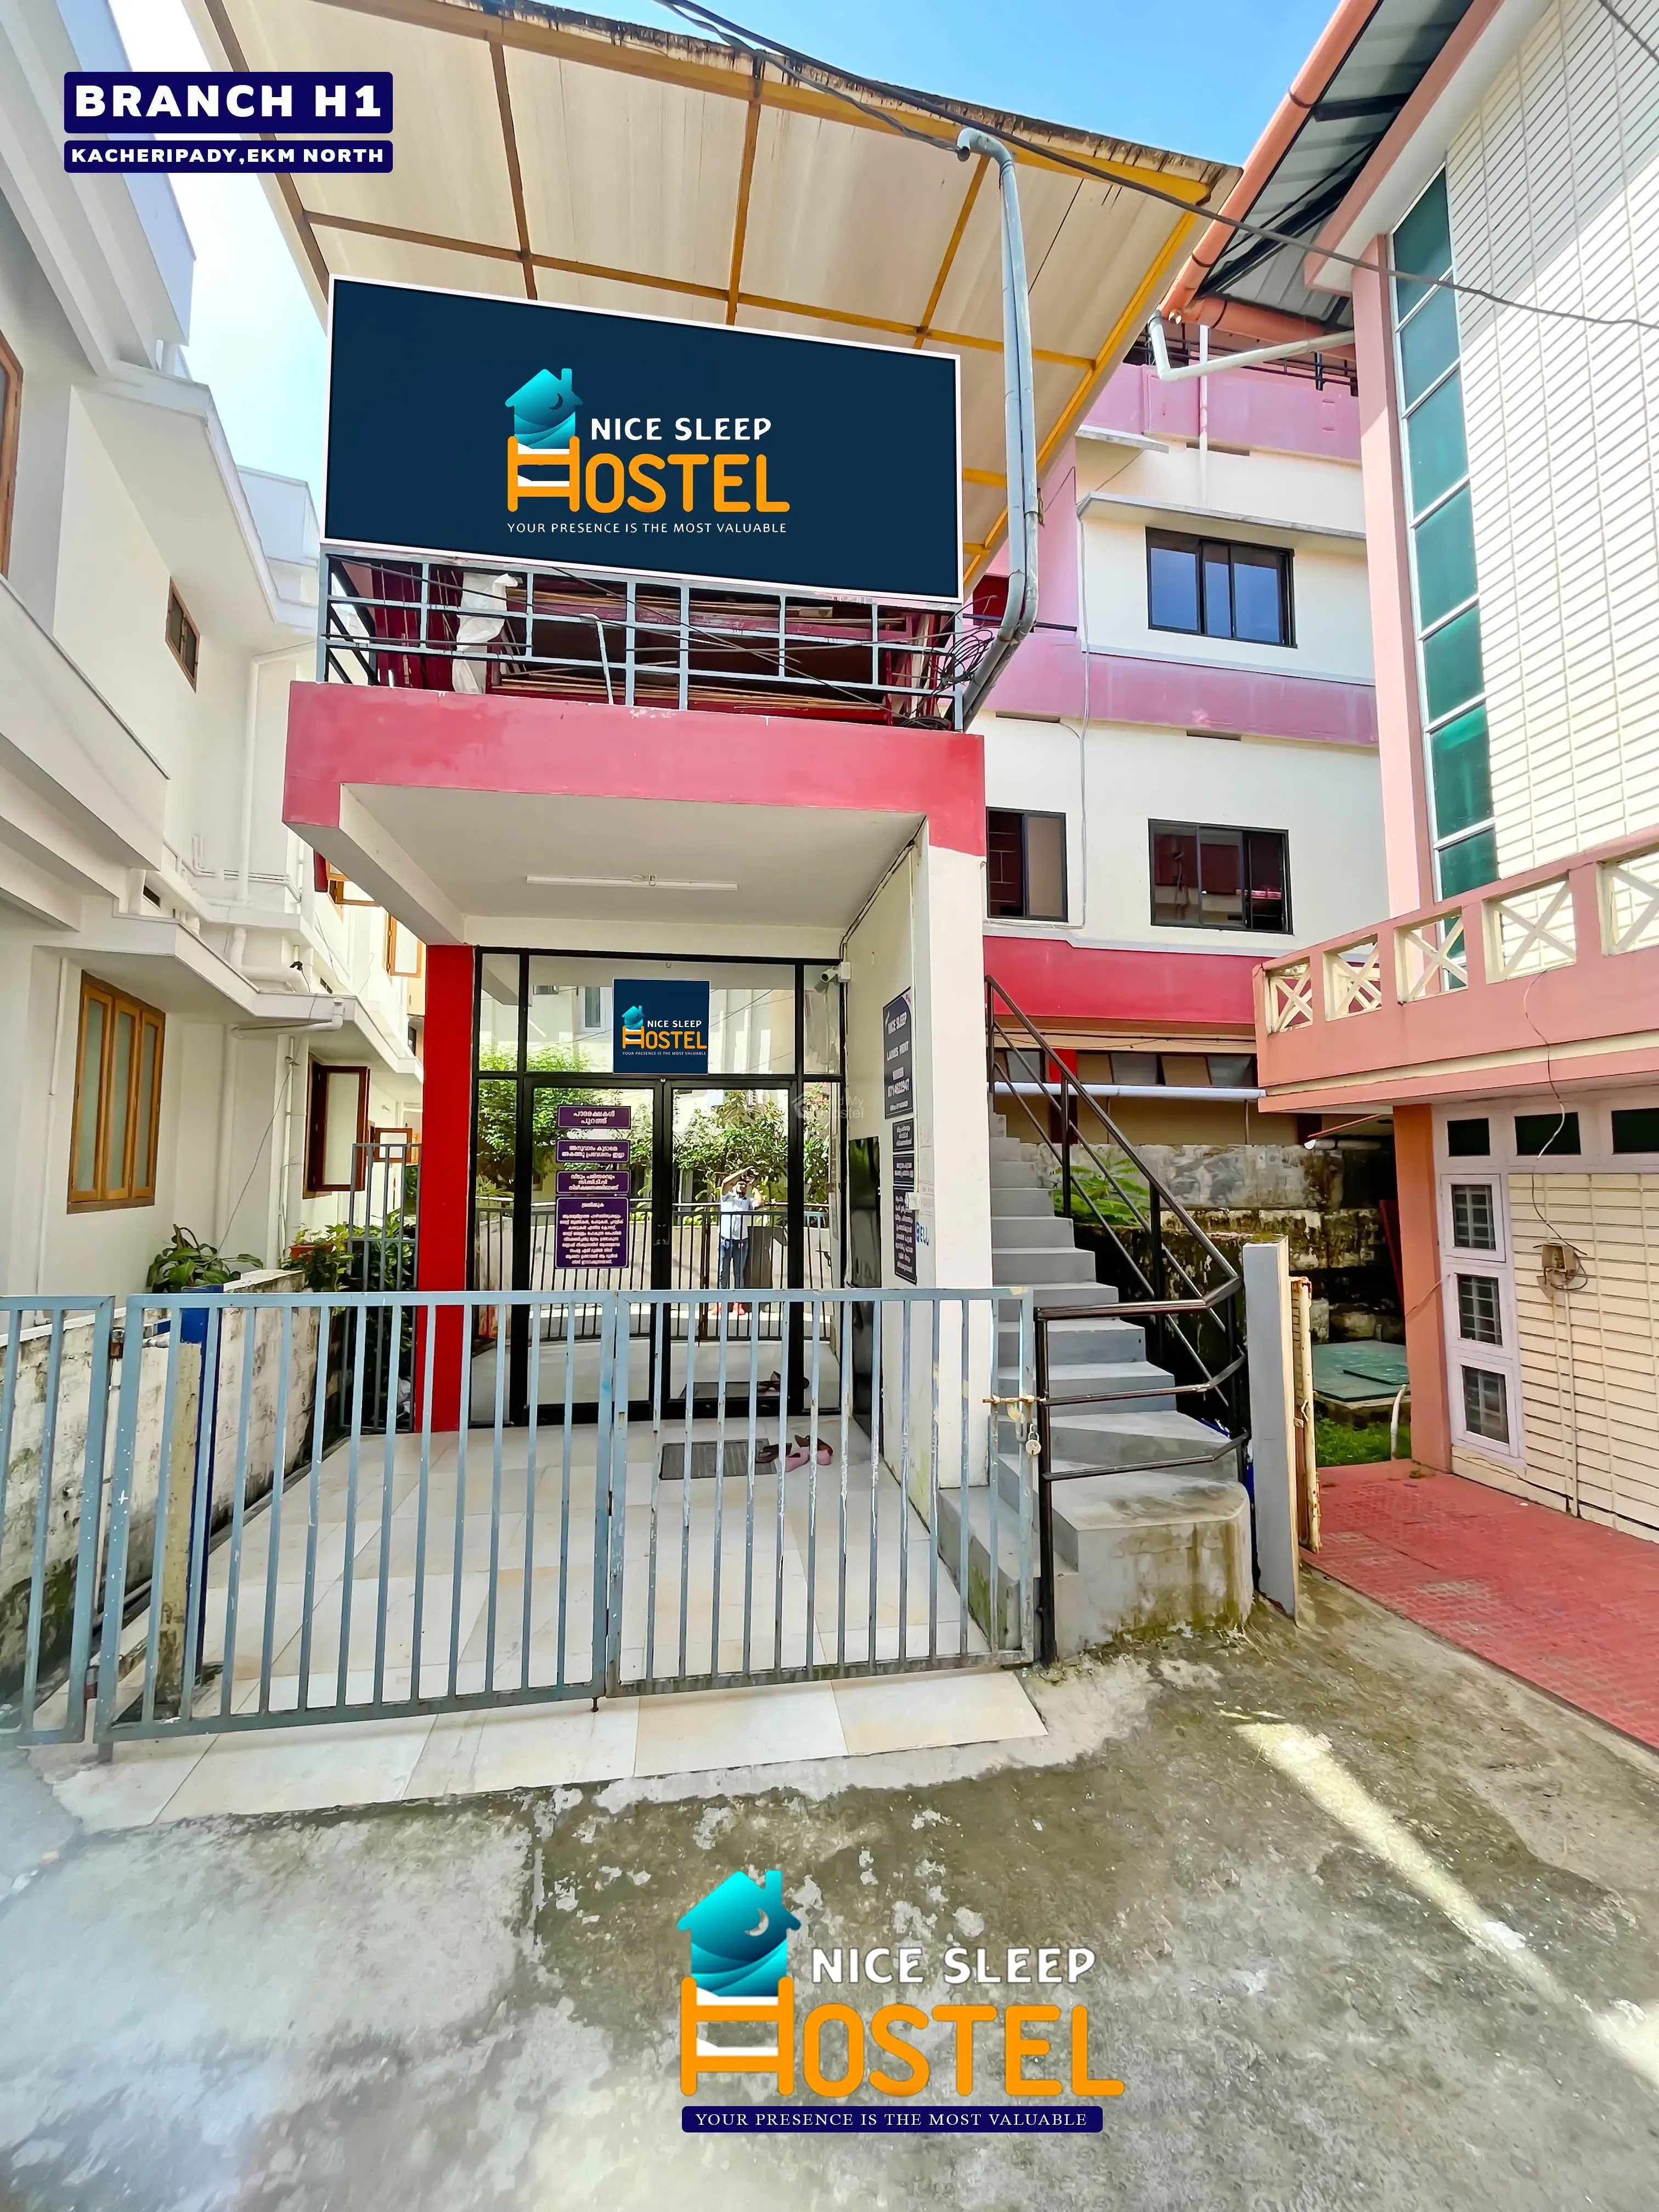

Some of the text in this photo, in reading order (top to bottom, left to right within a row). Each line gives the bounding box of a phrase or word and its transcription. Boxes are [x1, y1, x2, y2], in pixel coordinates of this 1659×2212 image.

[591, 417, 771, 441] NICE SLEEP
[507, 436, 791, 514] HOSTEL
[507, 522, 787, 533] YOUR PRESENCE IS THE MOST VALUABLE
[622, 1025, 707, 1049] HOSTEL
